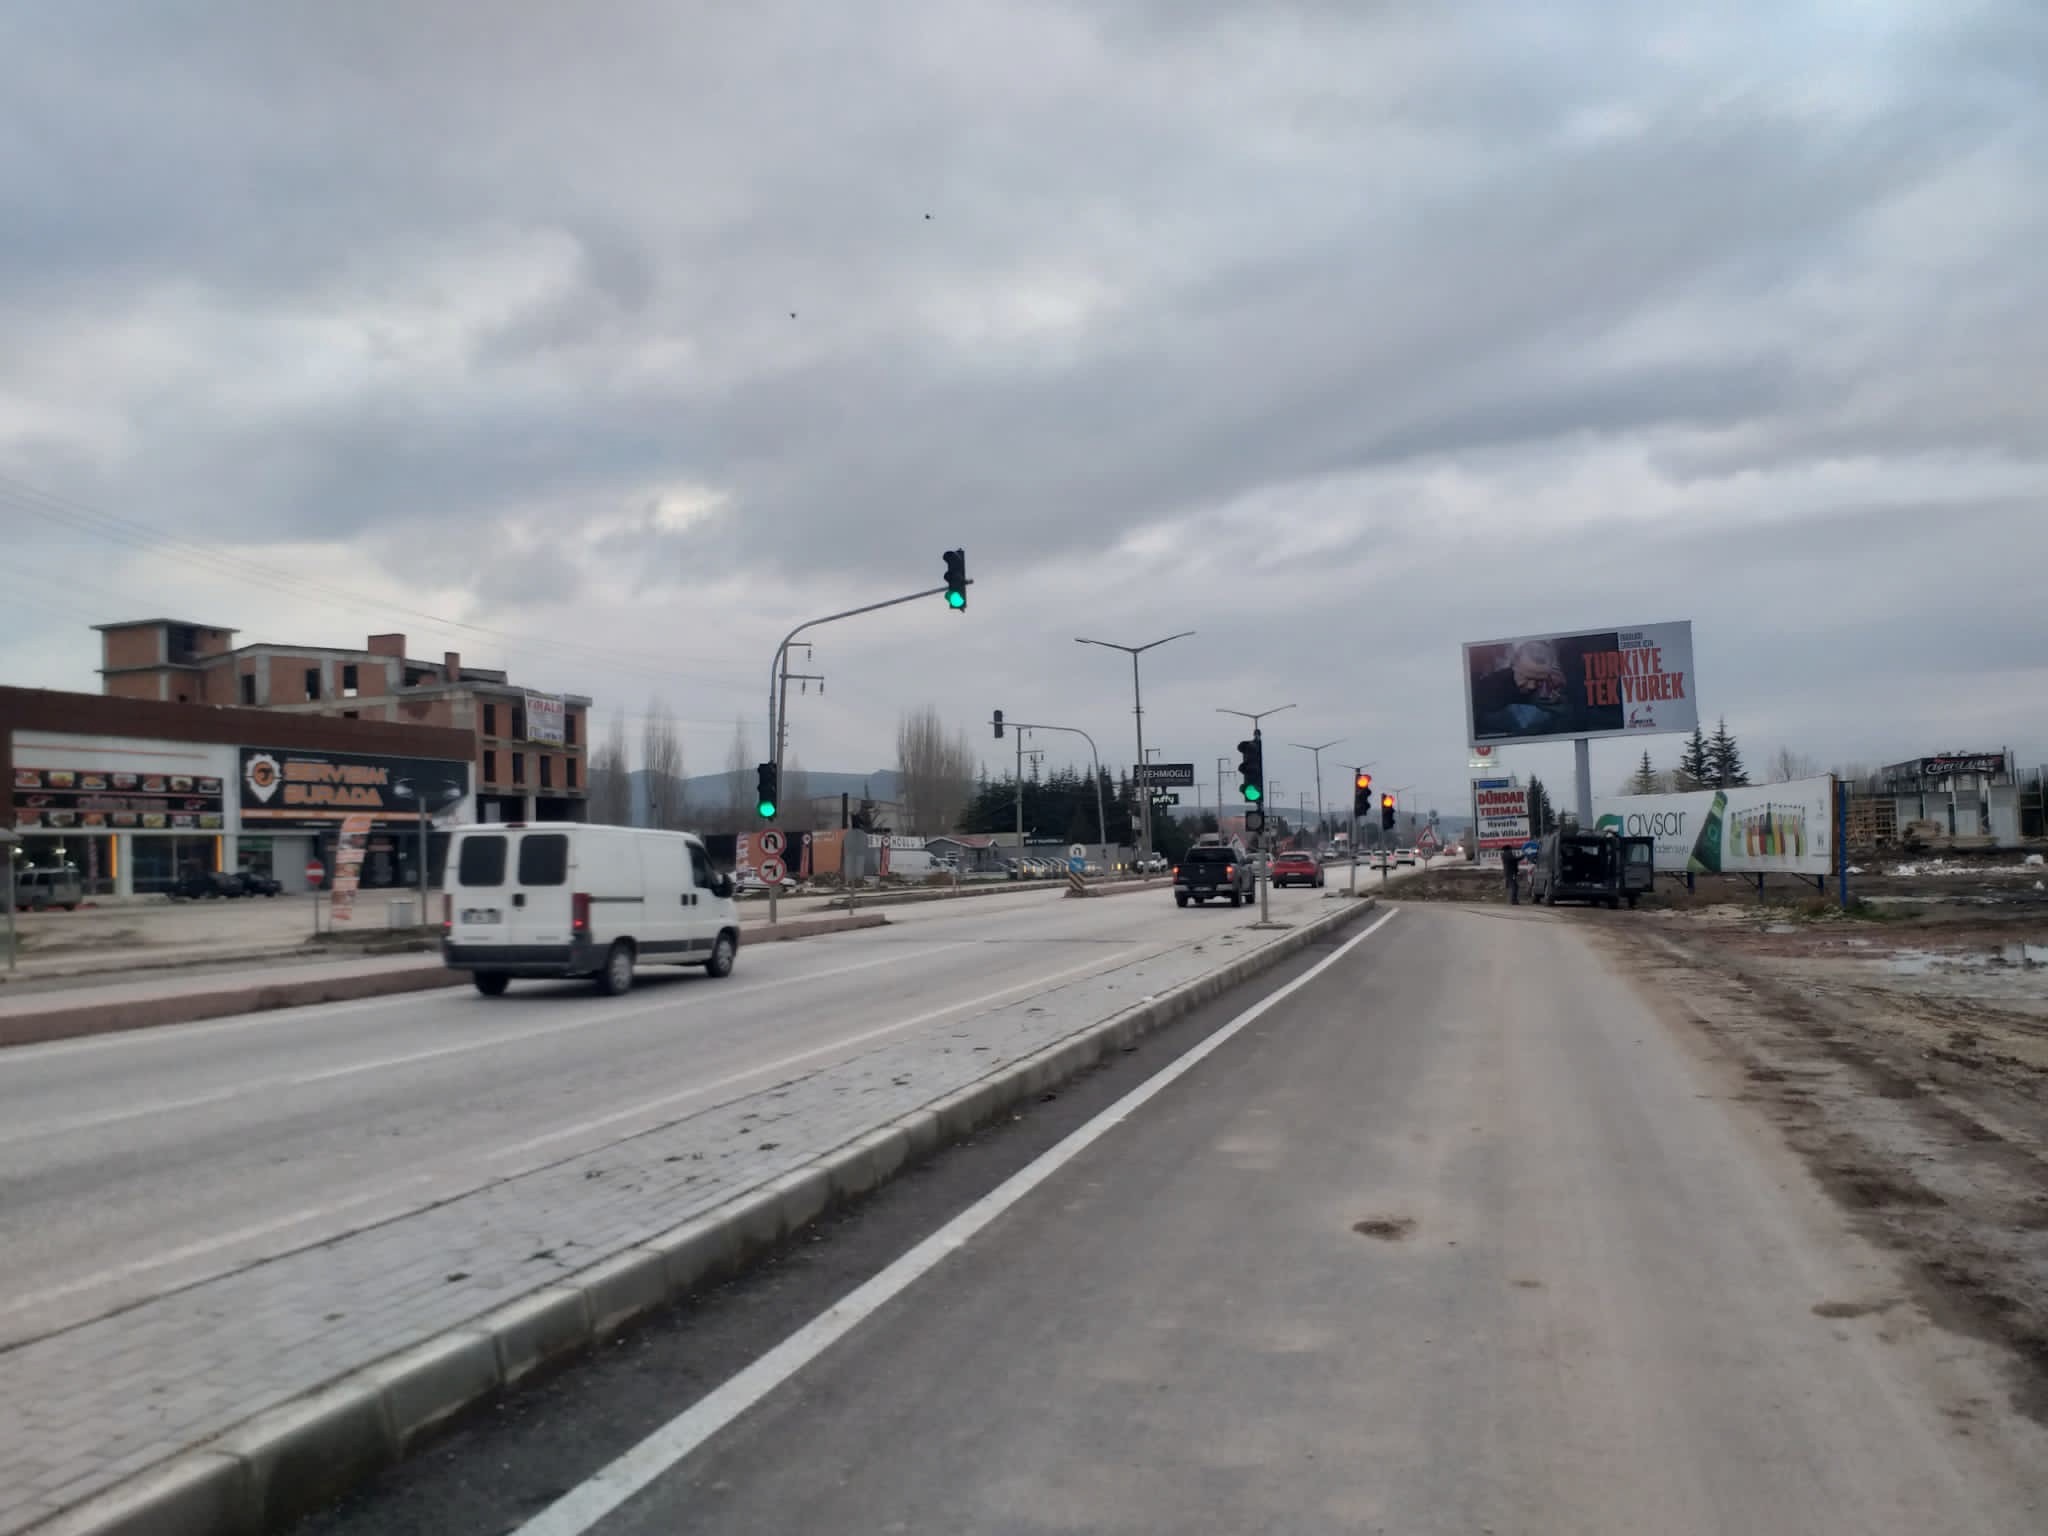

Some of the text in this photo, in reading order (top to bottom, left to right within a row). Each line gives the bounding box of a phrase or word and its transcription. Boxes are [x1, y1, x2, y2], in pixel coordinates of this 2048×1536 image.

[1584, 672, 1686, 706] TEK YÜREK
[1478, 790, 1525, 805] DÜNDAR
[1480, 807, 1526, 817] TERMAL
[1626, 811, 1688, 841] avşar
